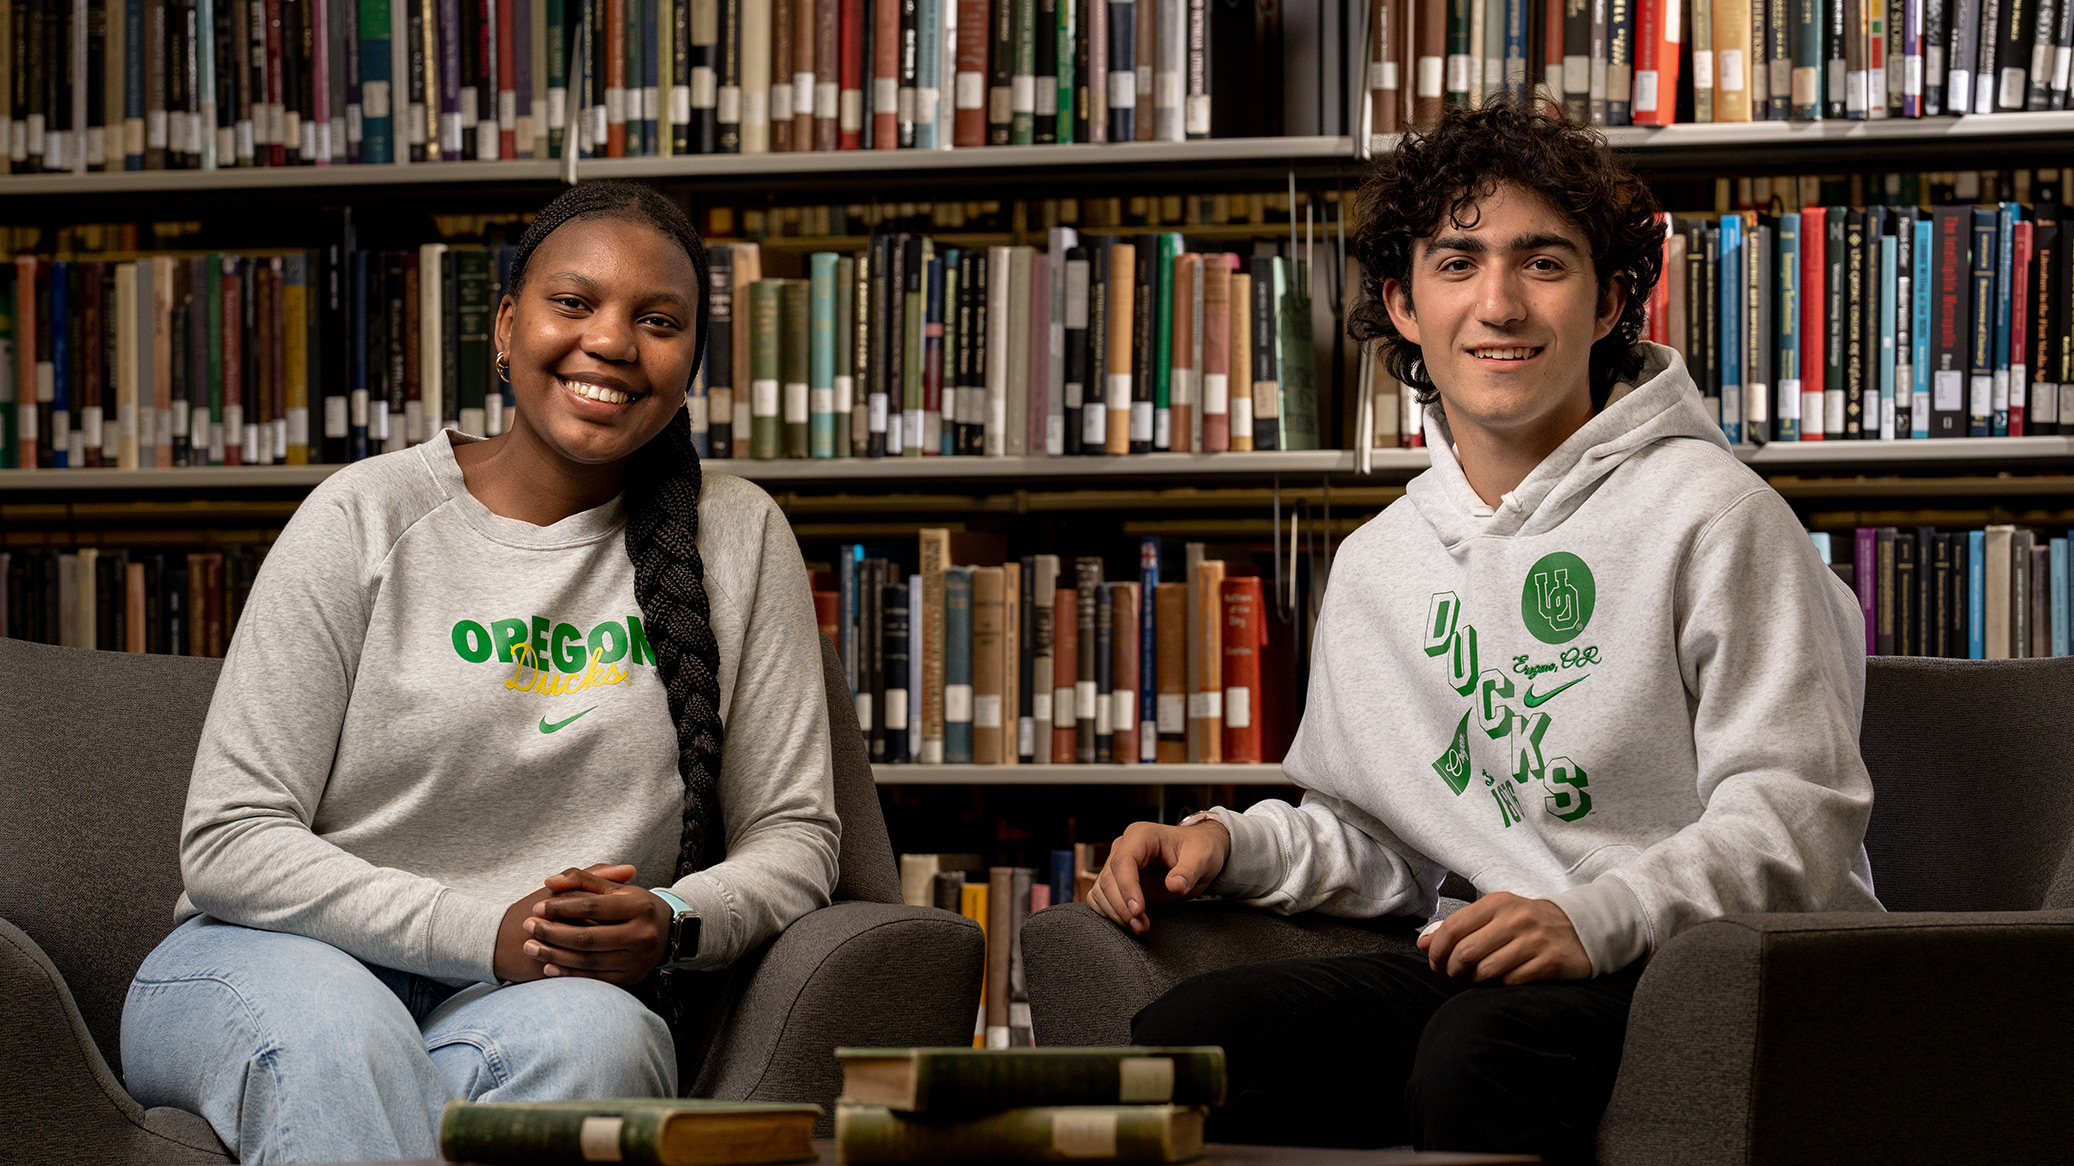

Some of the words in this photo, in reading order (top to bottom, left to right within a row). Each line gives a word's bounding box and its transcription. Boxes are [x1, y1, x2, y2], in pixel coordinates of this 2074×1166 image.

[1943, 215, 1959, 235] The
[2039, 249, 2051, 291] Literature
[1534, 568, 1580, 632] UO
[451, 615, 657, 674] OREGON
[1560, 645, 1602, 669] OR
[1424, 590, 1593, 823] DUCKS
